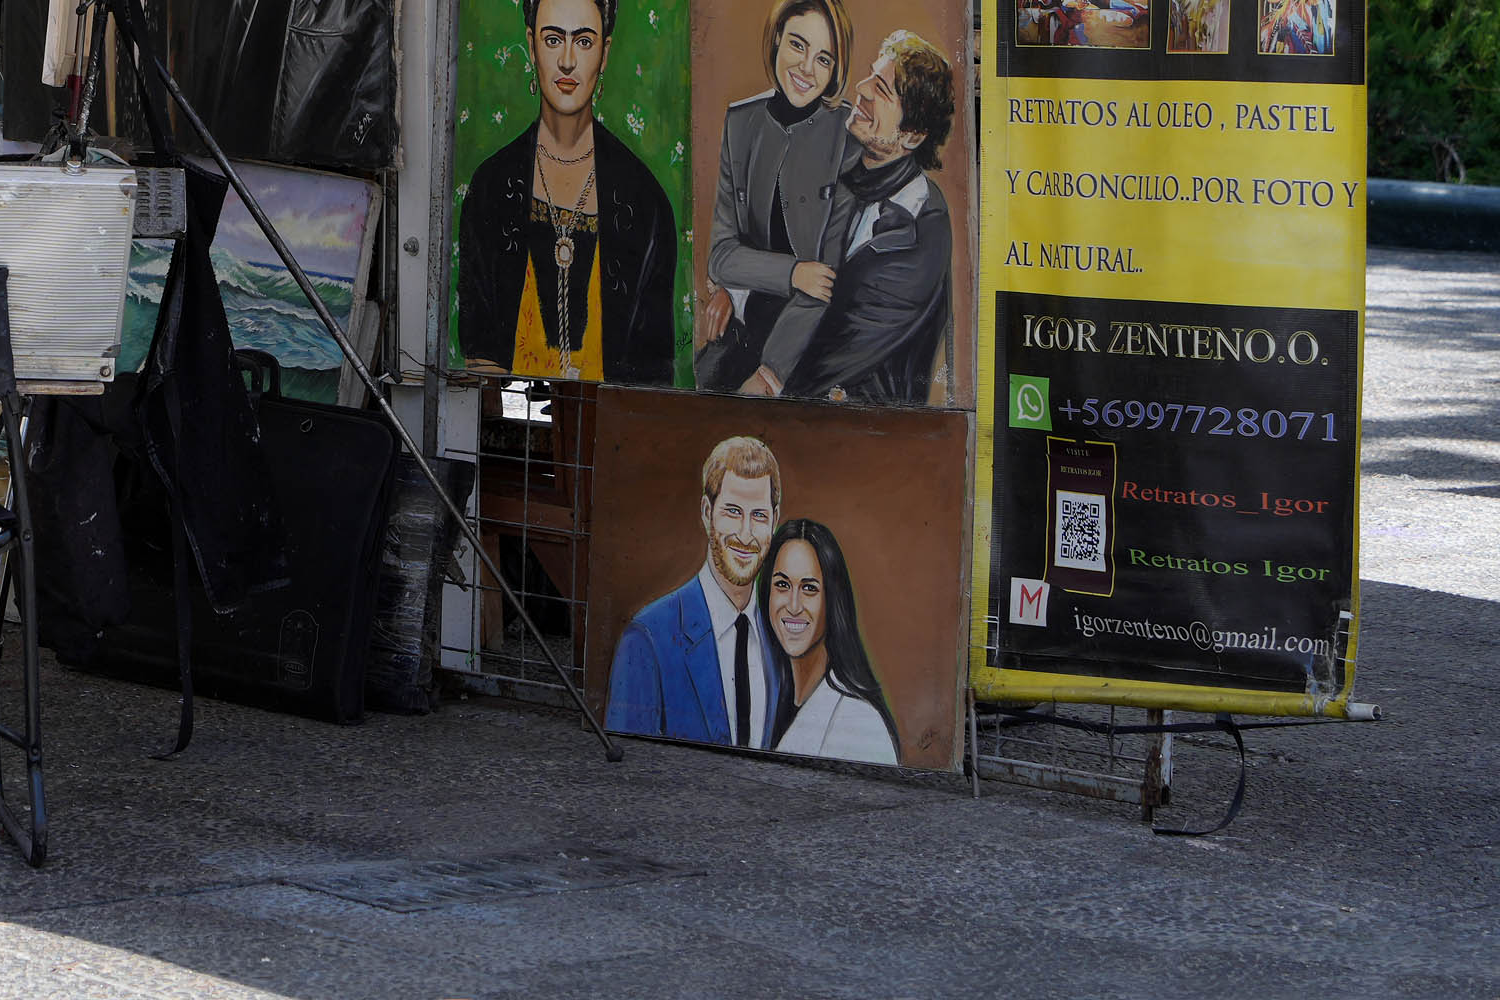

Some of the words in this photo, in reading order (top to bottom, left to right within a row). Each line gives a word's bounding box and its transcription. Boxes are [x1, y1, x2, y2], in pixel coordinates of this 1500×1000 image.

[1008, 98, 1117, 126] RETRATOS
[1125, 102, 1152, 128] AL
[1157, 102, 1213, 129] OLEO
[1235, 104, 1335, 133] PASTEL
[1005, 170, 1021, 195] Y
[1252, 179, 1334, 208] FOTO
[1342, 182, 1360, 208] Y
[1004, 241, 1033, 268] AL
[1022, 315, 1100, 353] IGOR
[1058, 398, 1338, 442] +56997728071
[1121, 481, 1329, 516] Retratos_Igor
[1129, 549, 1249, 576] Retratos
[1263, 560, 1331, 583] Igor
[1074, 607, 1330, 657] igorzenteno@gmail.com
